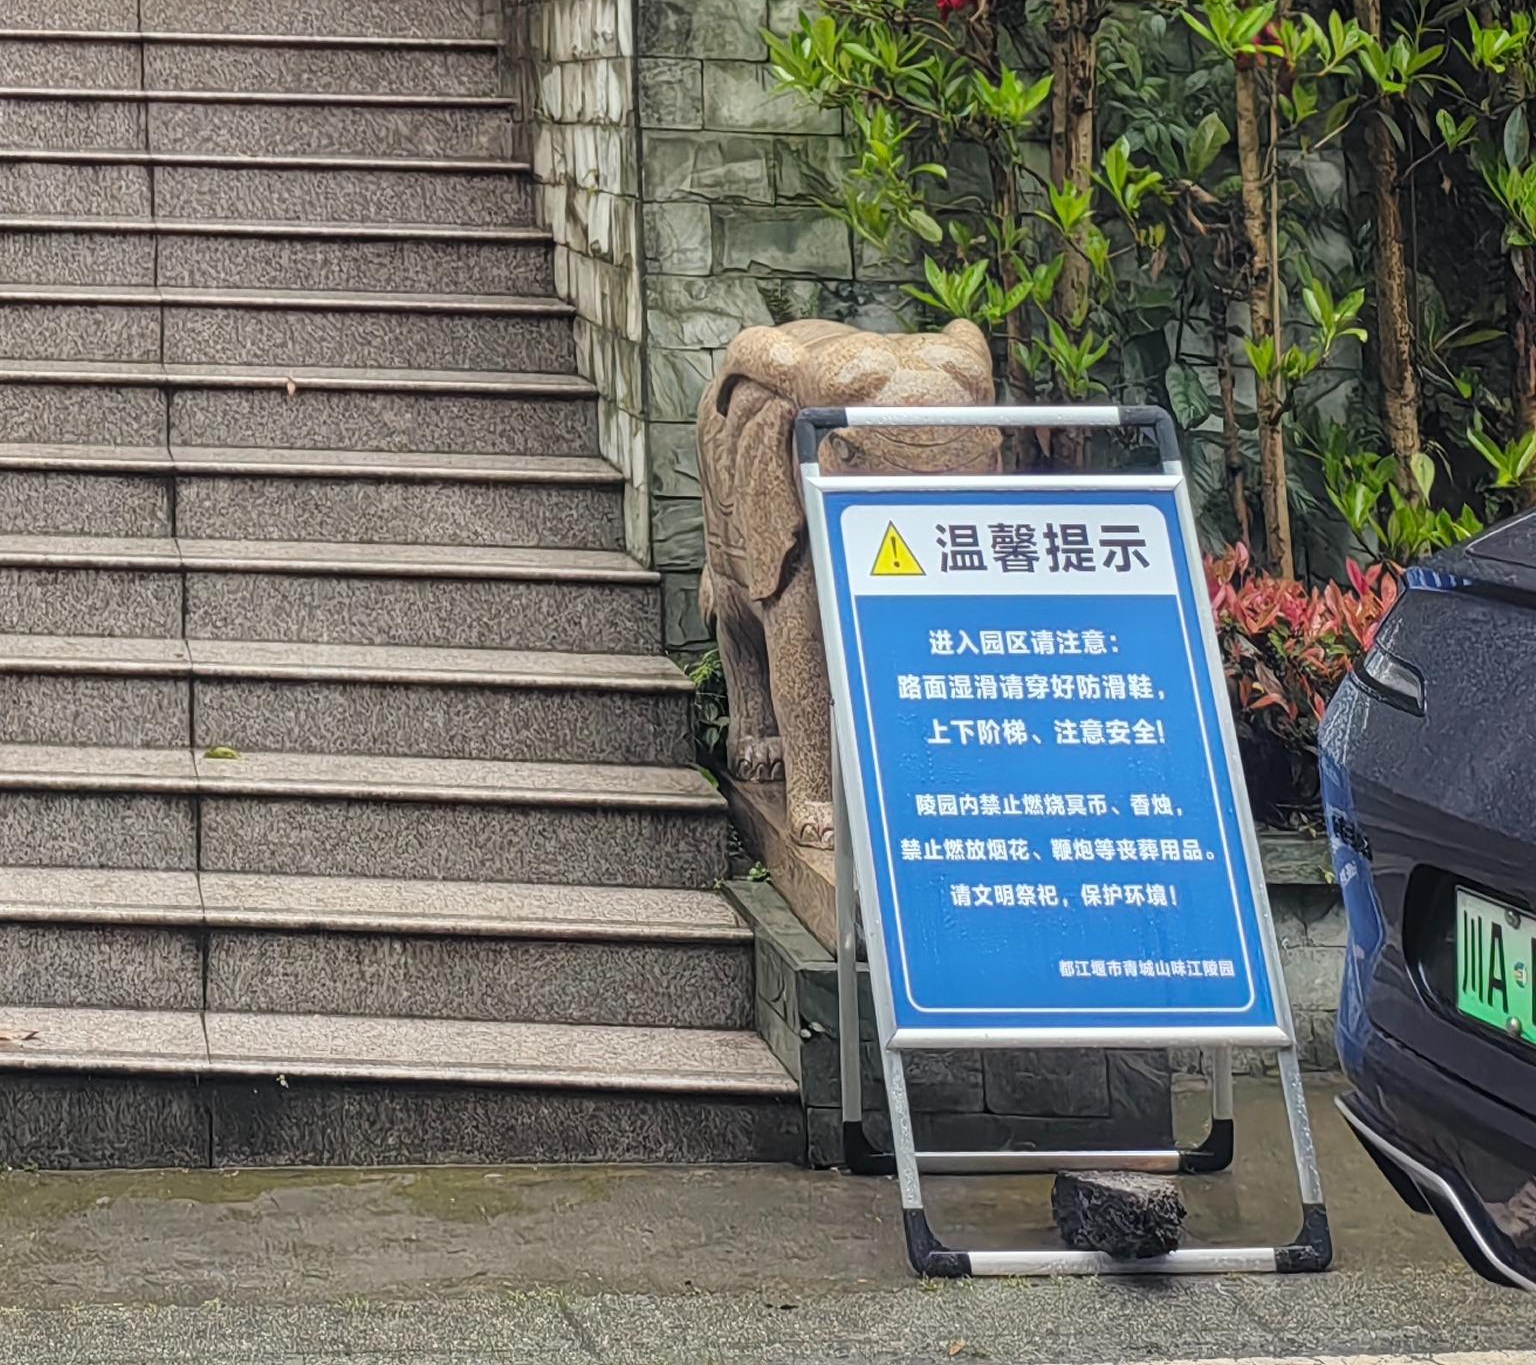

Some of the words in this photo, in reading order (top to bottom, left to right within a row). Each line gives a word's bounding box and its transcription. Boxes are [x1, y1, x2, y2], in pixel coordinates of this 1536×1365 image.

[935, 522, 1150, 574] 温馨提示
[928, 629, 1119, 655] 进入园区请注意：
[897, 674, 1164, 700] 路面湿滑请穿好防滑鞋，
[927, 718, 1165, 745] 上下阶梯、注意安全！
[915, 794, 1184, 817] 陵园内禁止燃烧冥币、香烛，
[901, 839, 1215, 861] 禁止燃放烟花、鞭炮等丧葬用品。
[1059, 960, 1236, 978] 都江堰市青城山味江陵园
[1462, 910, 1536, 1026] 川A
